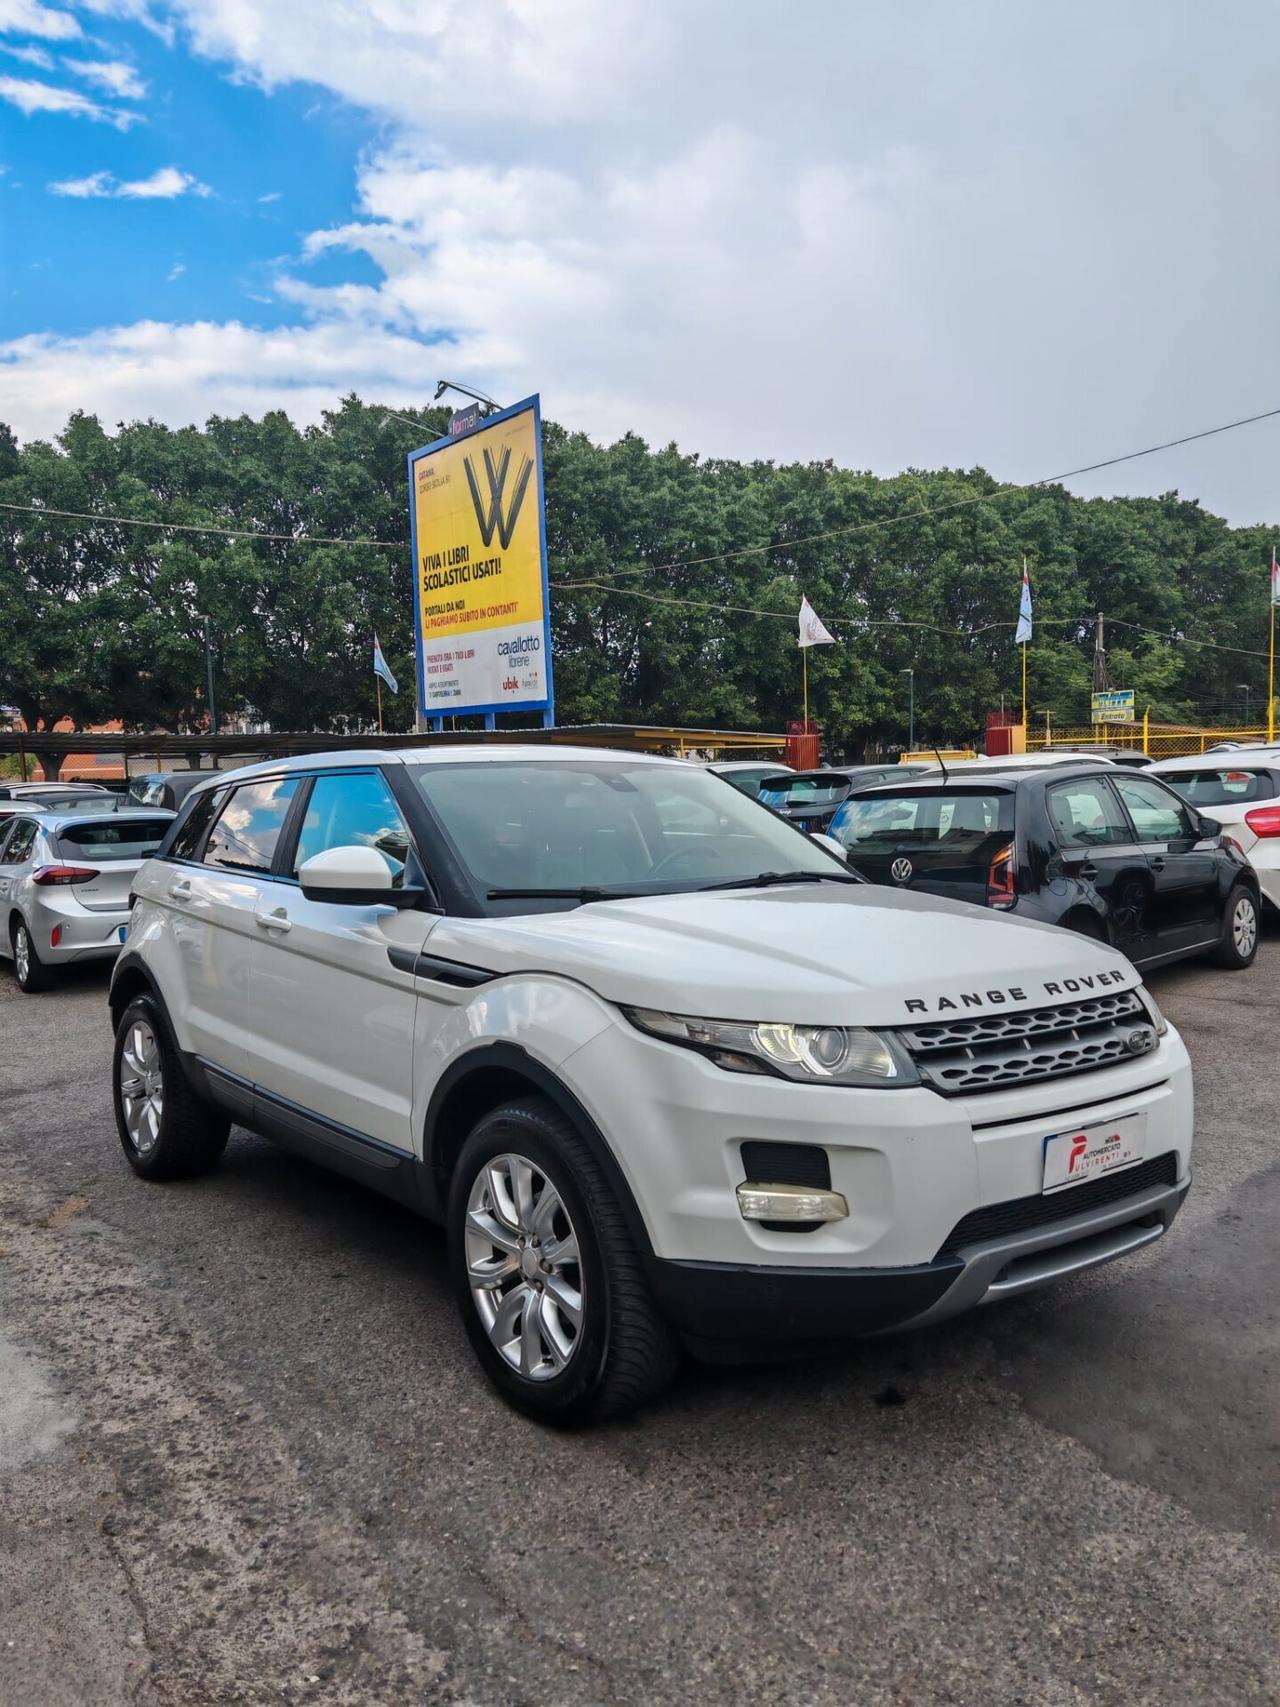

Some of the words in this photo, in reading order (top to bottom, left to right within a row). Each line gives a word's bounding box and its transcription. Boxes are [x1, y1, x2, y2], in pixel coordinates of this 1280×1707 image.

[423, 553, 441, 572] VIVA
[443, 551, 446, 567] I
[448, 545, 469, 566] LIBRI
[424, 565, 470, 592] SCOLASTICI
[472, 557, 501, 580] USATI!
[425, 603, 445, 616] PORTALI
[447, 601, 454, 612] DA
[455, 599, 465, 610] NOI
[430, 613, 458, 628] PAGHIAMO
[459, 609, 479, 623] SUBITO
[480, 608, 486, 619] IN
[497, 635, 540, 656] cavallotto
[502, 675, 519, 690] ubik
[904, 987, 1027, 1013] RANGE
[1043, 970, 1125, 996] ROVER
[1083, 1142, 1121, 1159] AUTOMERCATO
